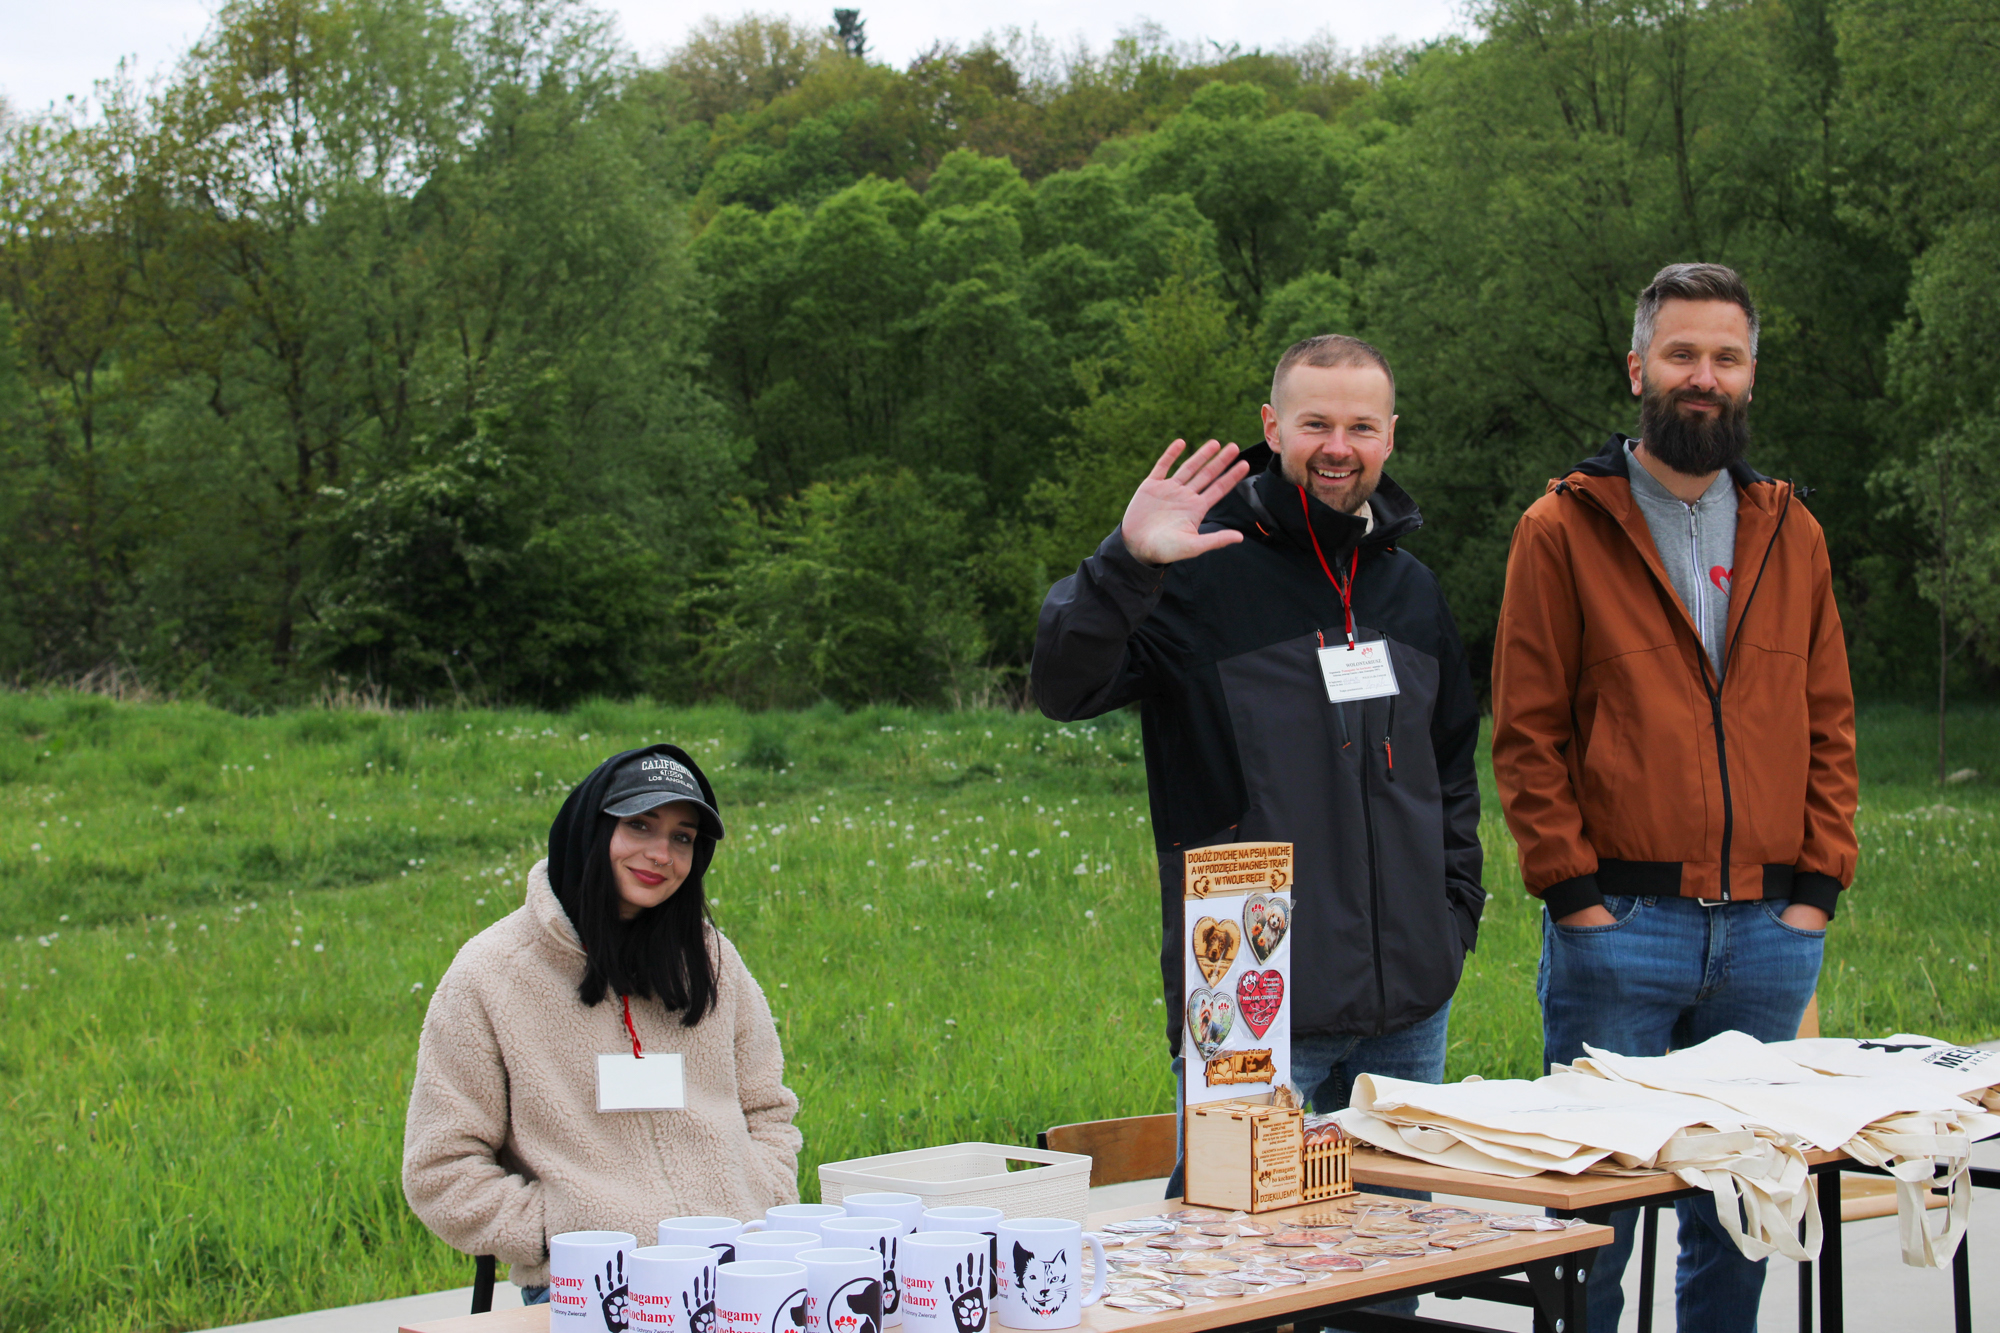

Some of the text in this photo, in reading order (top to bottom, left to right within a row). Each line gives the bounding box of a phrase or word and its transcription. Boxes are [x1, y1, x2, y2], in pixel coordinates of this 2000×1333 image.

[1188, 846, 1291, 864] DOŁÓŻ DYCHĘ NA PSIĄ MICHĘ
[1191, 859, 1288, 875] A W PODZIĘCE MAGNES TRAFI
[1215, 873, 1265, 885] W TWOJE RĘCE!
[1273, 1166, 1296, 1174] Pomagamy
[1278, 1174, 1297, 1182] kochamy
[1260, 1189, 1297, 1203] DZIĘKUJEMY!
